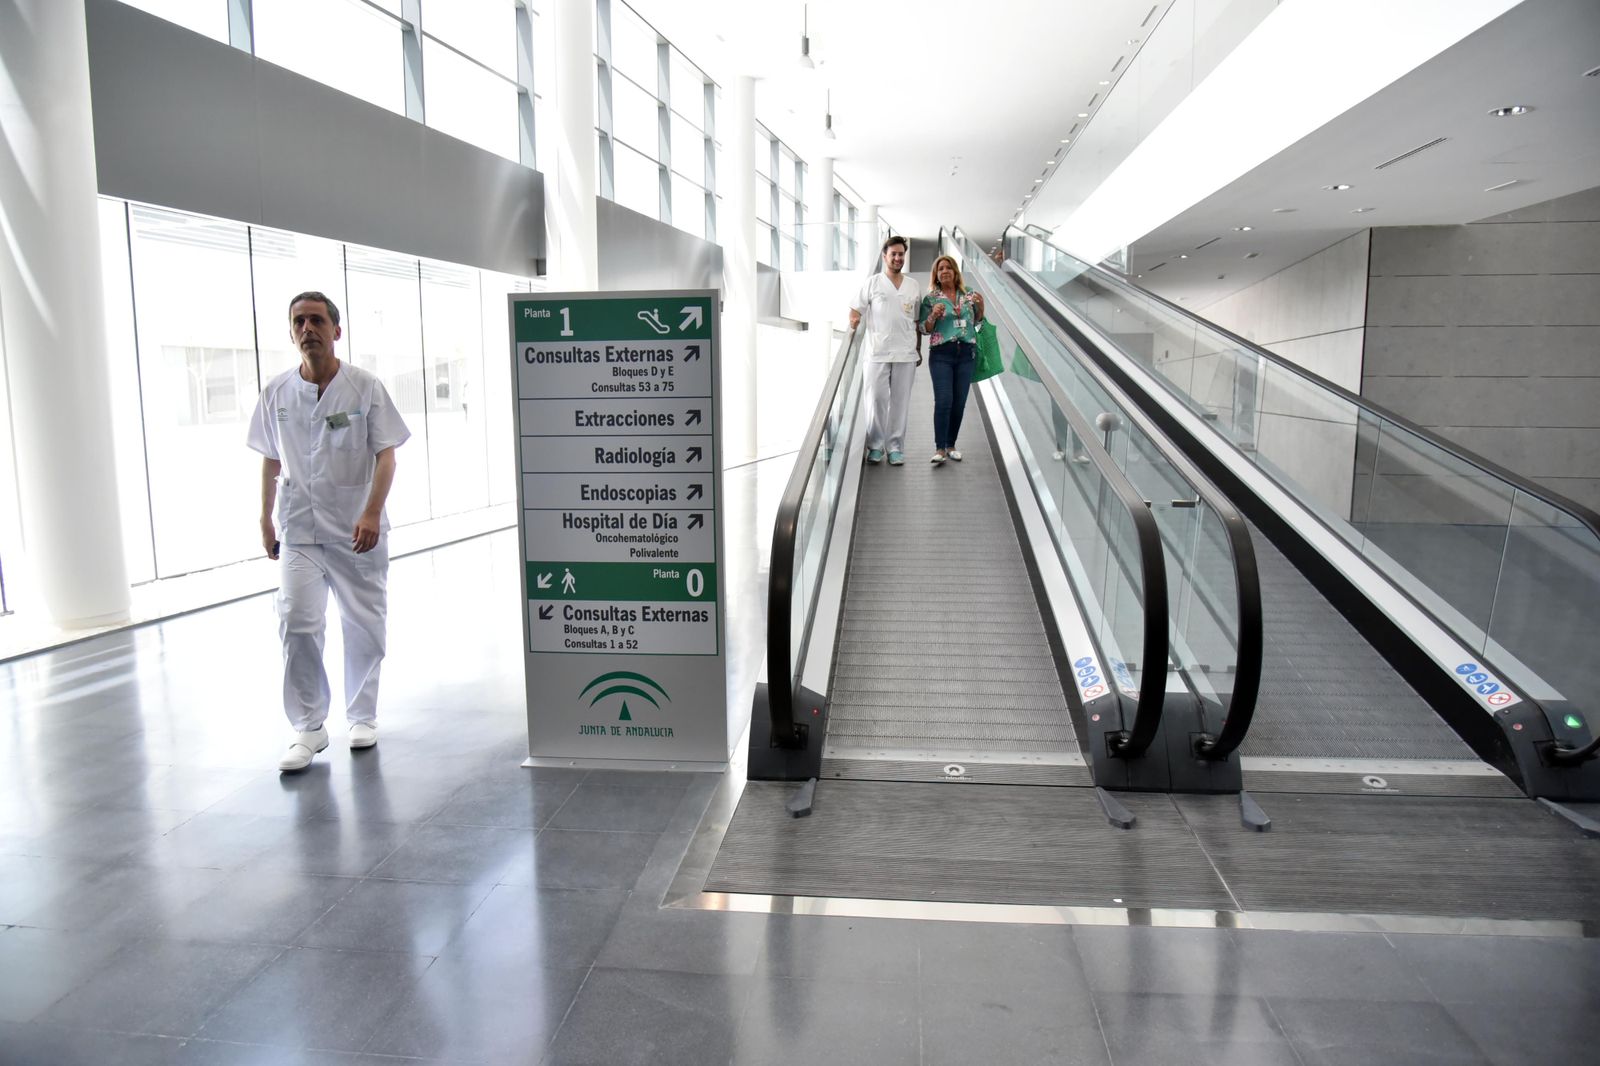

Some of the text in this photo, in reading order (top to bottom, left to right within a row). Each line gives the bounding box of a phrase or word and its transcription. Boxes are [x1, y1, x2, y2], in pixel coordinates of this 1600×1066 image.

[524, 308, 551, 318] Planta
[559, 307, 574, 337] 1
[525, 345, 674, 364] Consultas Externas
[612, 366, 674, 378] Bloques D y E
[592, 382, 636, 393] Consultas
[638, 382, 651, 392] 53
[662, 382, 674, 391] 75
[575, 410, 675, 427] Extracciones
[595, 447, 676, 467] Radiología
[581, 484, 677, 504] Endoscopias
[562, 512, 678, 532] Hospital de Día
[595, 533, 679, 545] Oncohematológico
[630, 548, 679, 558] Polivalente
[653, 569, 680, 578] Planta
[686, 568, 704, 597] 0
[563, 605, 708, 622] Consultas Externas
[564, 625, 634, 637] Bloques A, B y C
[564, 639, 607, 649] Consultas
[610, 640, 615, 649] 1
[626, 640, 638, 650] 52
[578, 725, 674, 737] JUNTA DE ANDALUCIA
